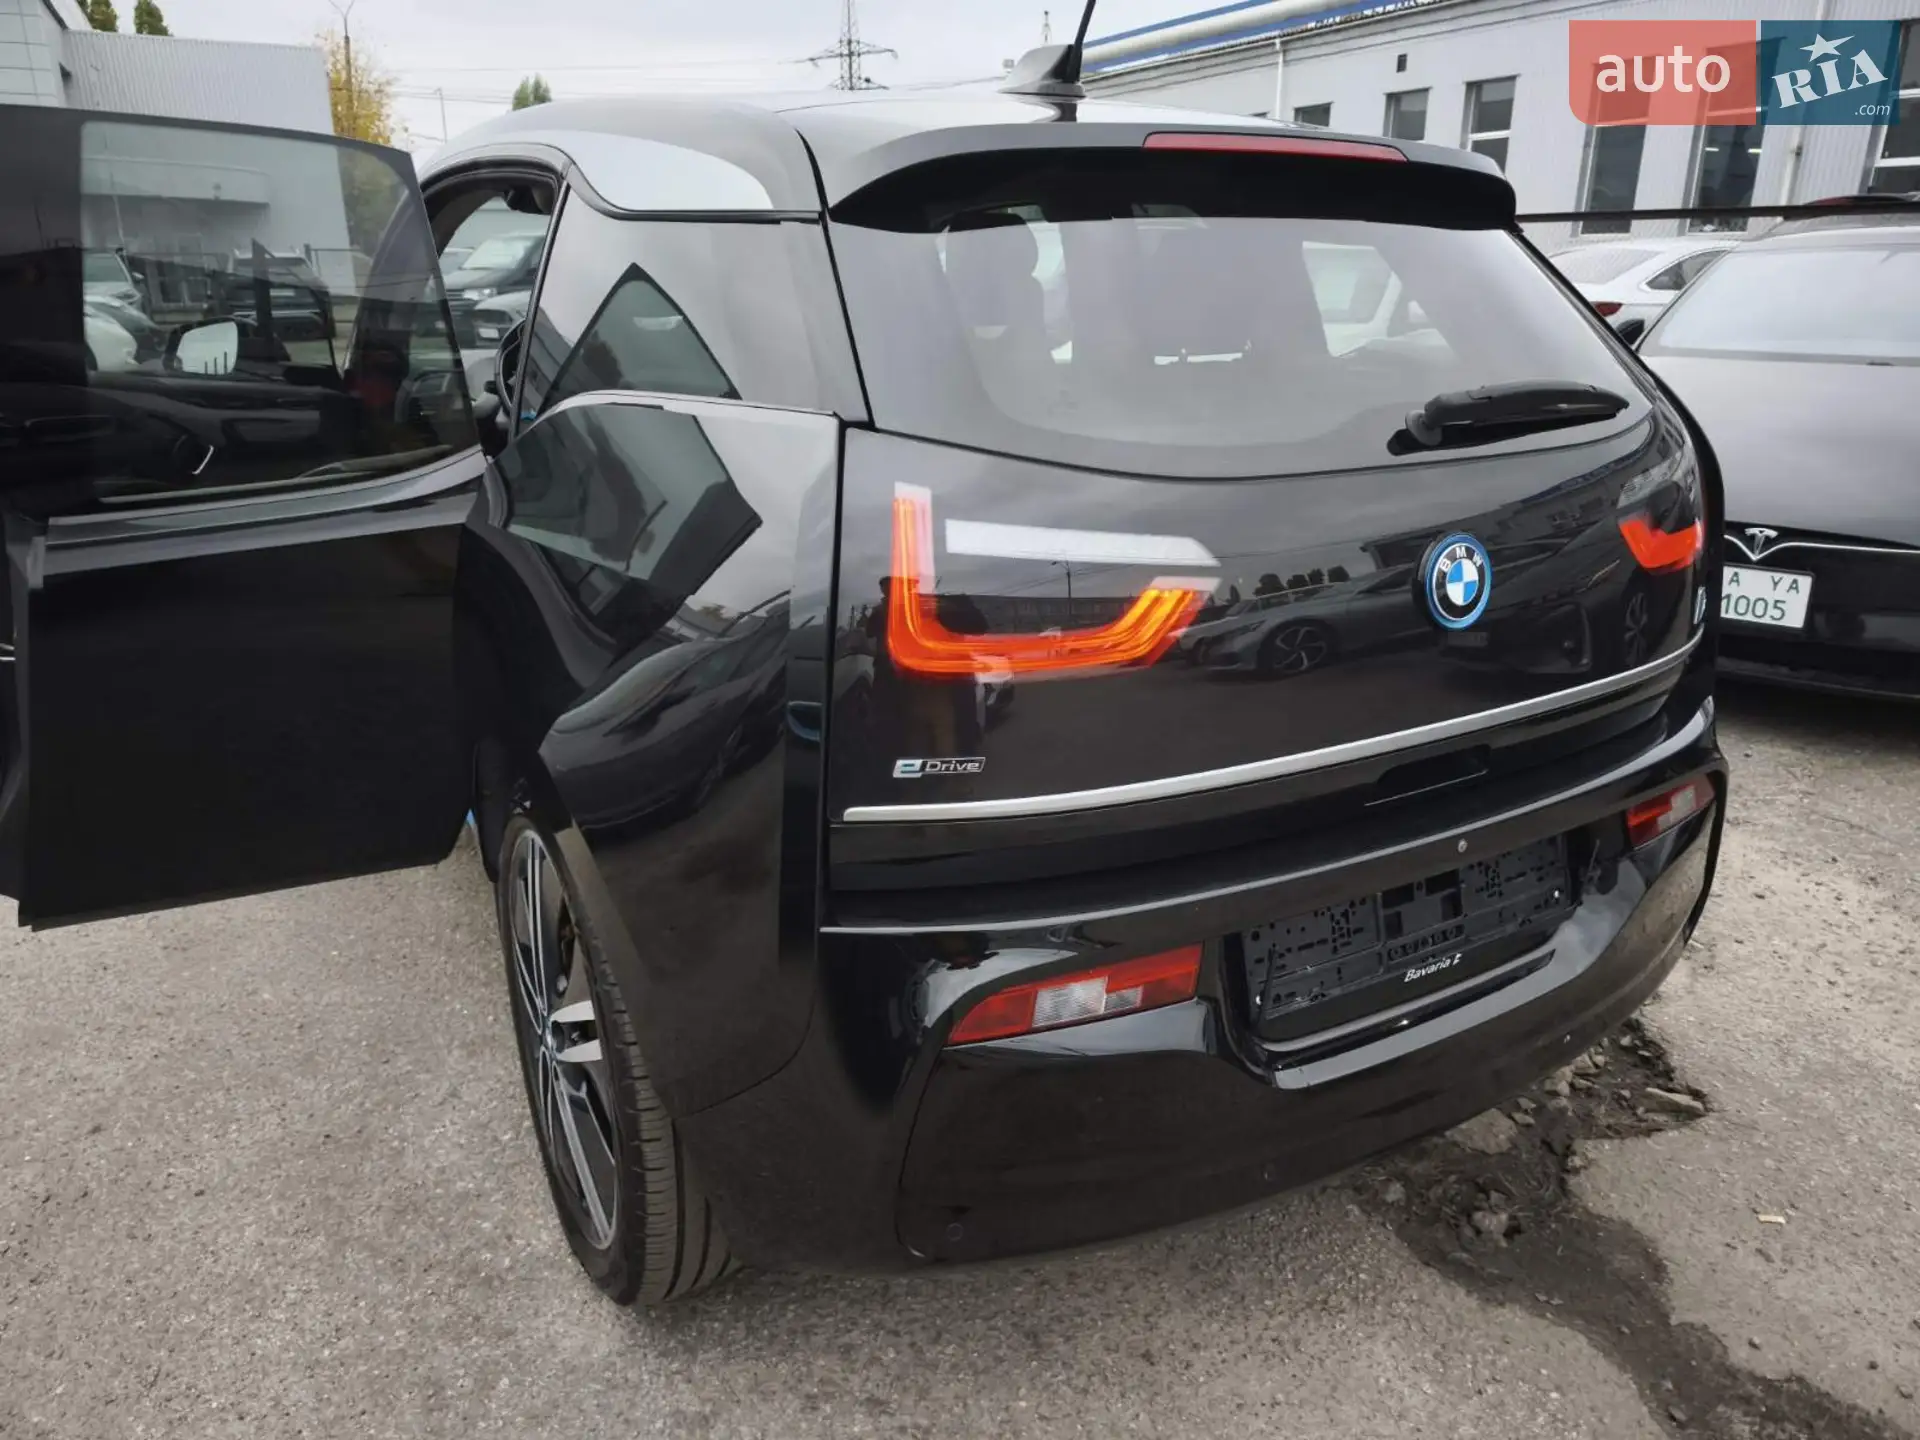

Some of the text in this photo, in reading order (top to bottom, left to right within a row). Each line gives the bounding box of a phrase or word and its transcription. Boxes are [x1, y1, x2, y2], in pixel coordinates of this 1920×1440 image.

[1770, 575, 1800, 594] YA
[1721, 593, 1786, 621] 1005
[1403, 957, 1452, 983] Bavaria
